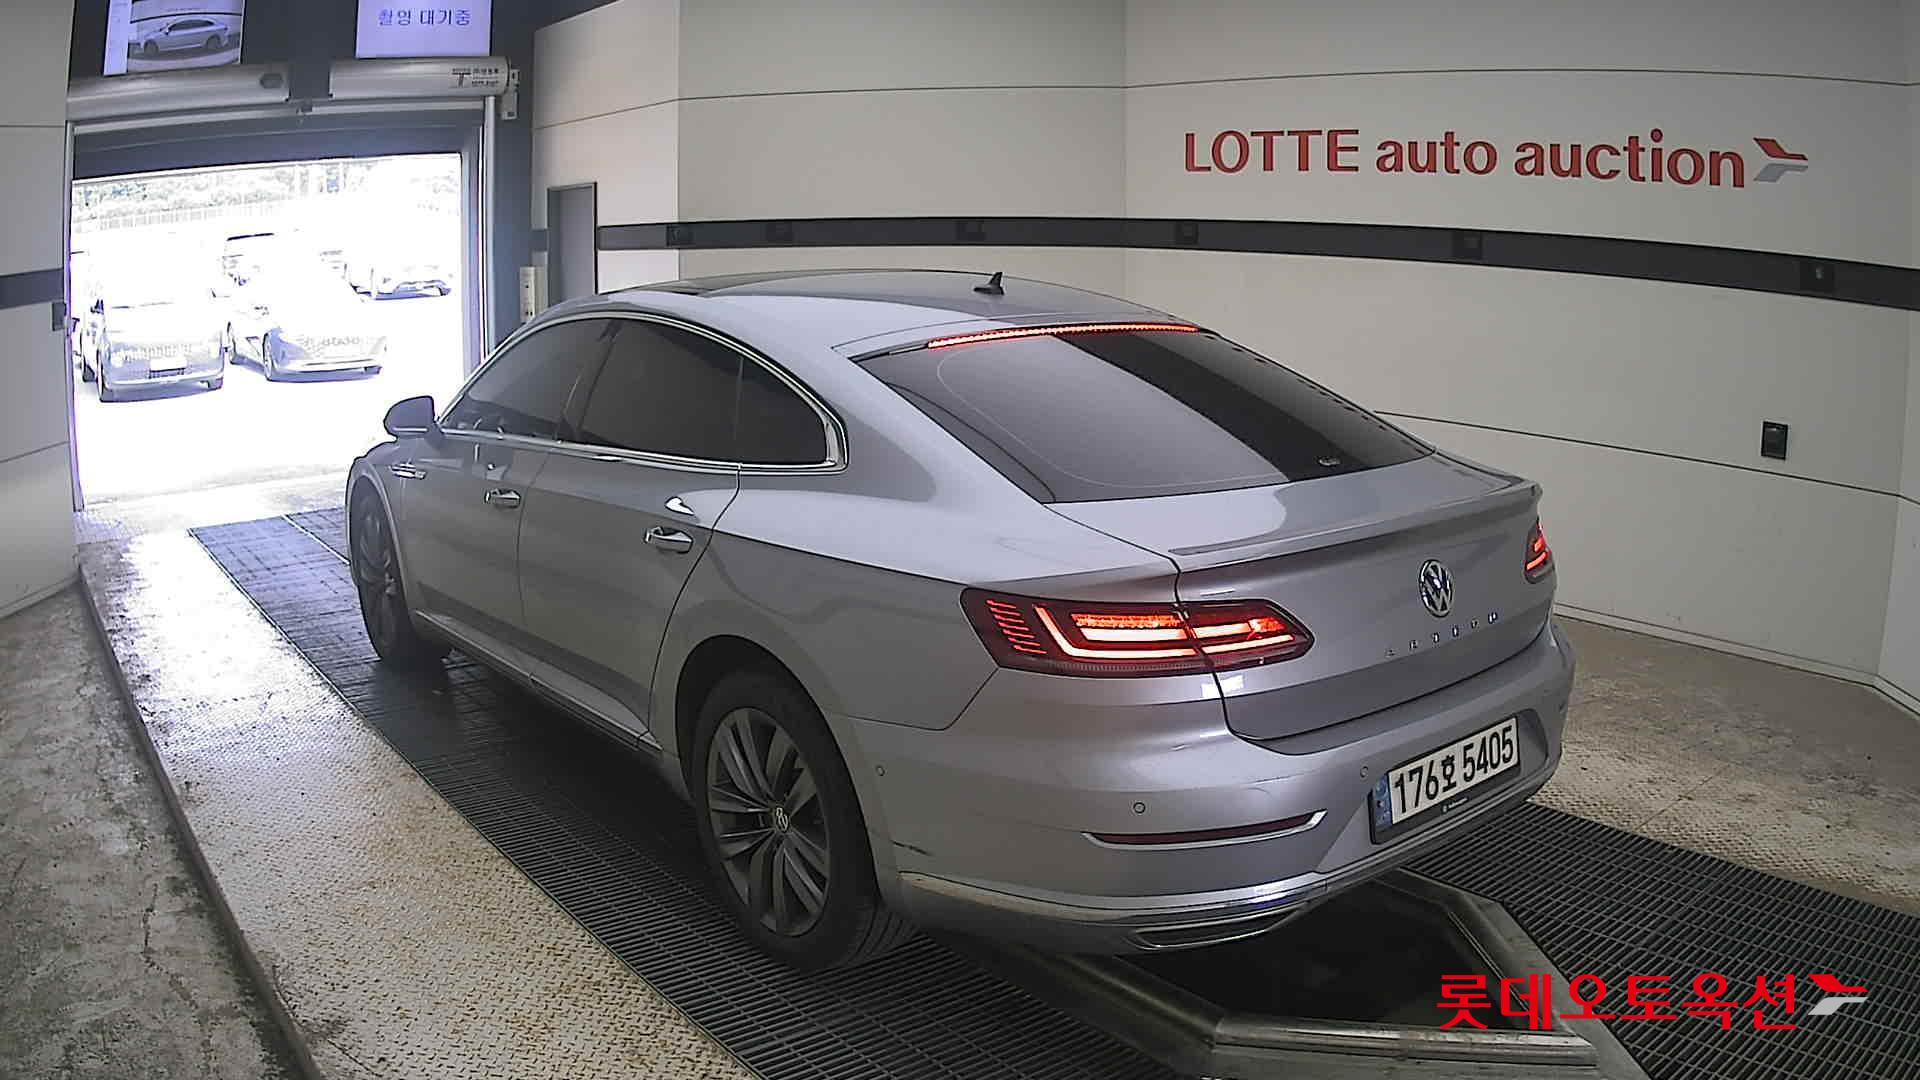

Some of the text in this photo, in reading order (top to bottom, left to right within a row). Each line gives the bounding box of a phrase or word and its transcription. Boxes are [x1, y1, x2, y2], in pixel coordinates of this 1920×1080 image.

[420, 9, 471, 26] 대기중
[1184, 129, 1745, 188] LOTTE auto auction
[1393, 725, 1514, 814] 176호 5405
